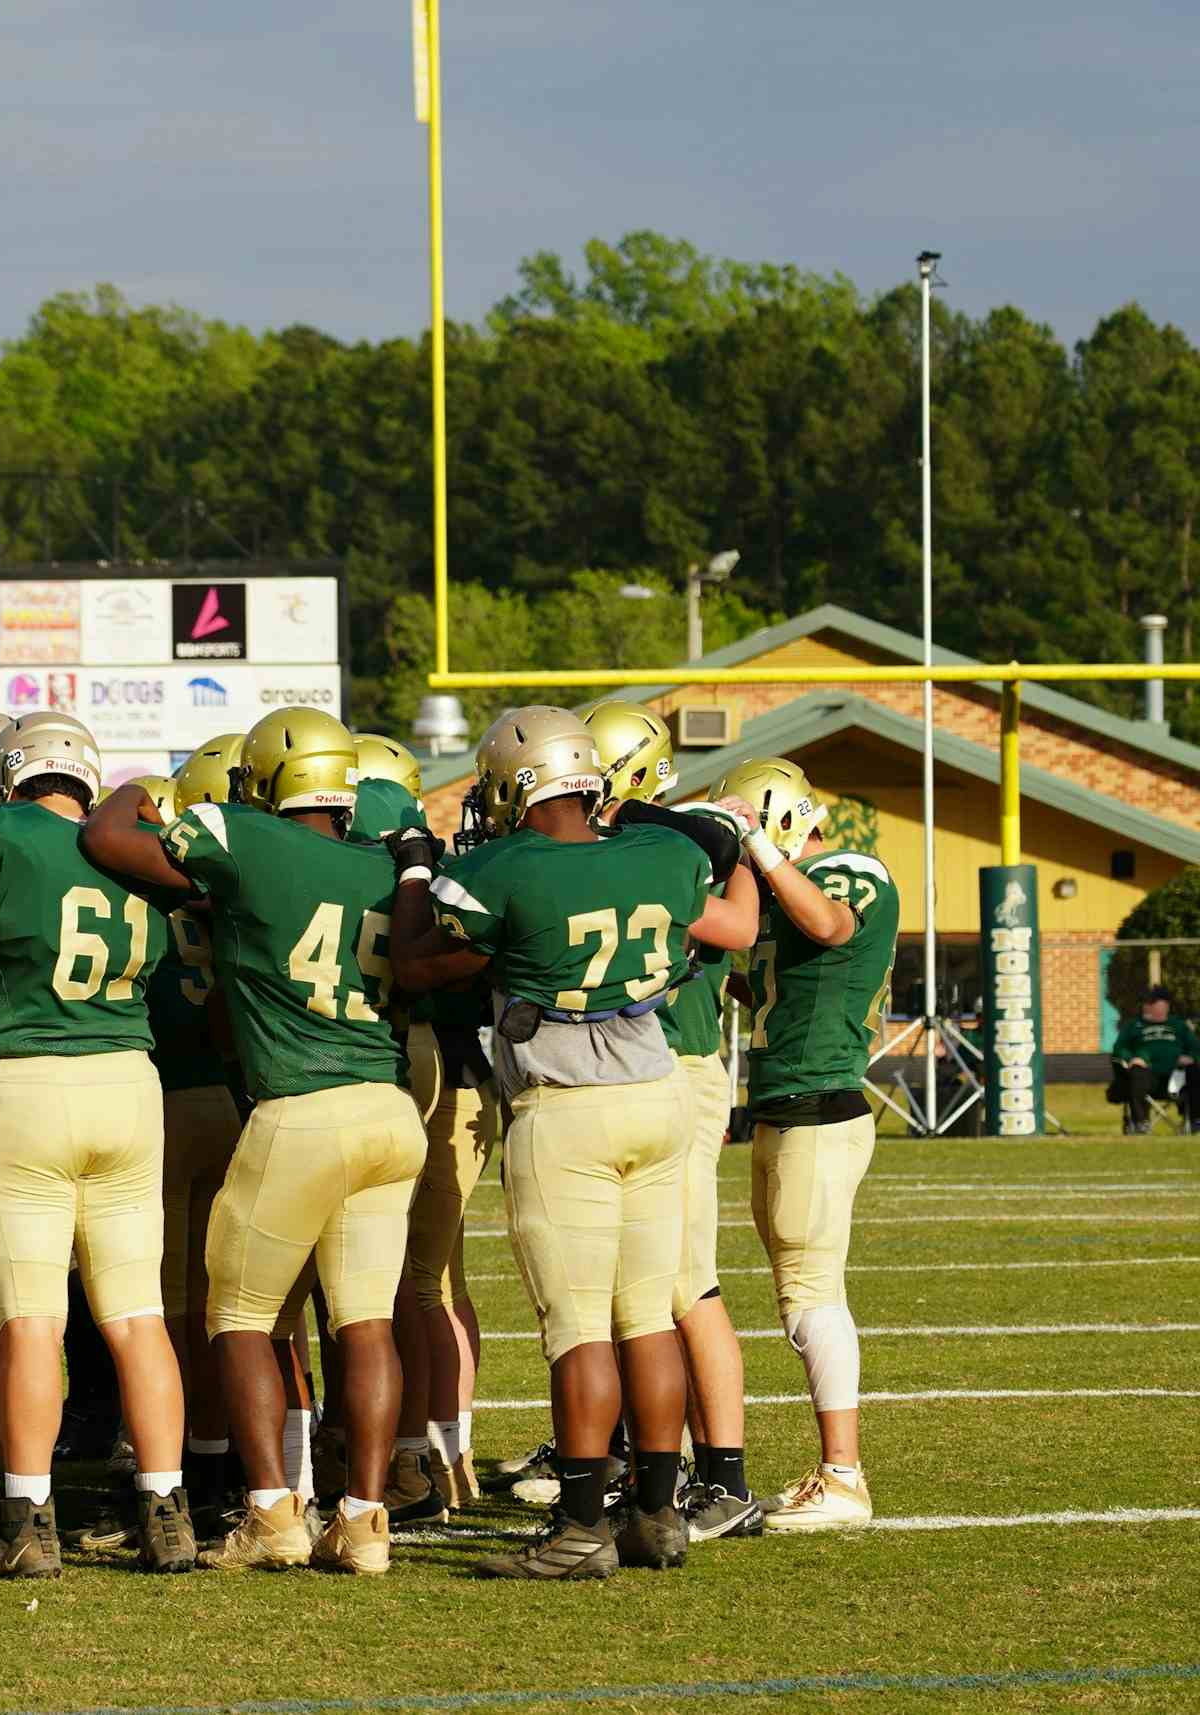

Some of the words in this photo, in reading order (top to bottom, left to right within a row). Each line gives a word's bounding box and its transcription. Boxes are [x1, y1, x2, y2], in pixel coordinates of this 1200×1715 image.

[259, 689, 334, 704] arauco
[7, 751, 23, 768] 22
[45, 760, 90, 778] Riddell
[658, 761, 669, 776] 22
[517, 769, 535, 787] 22
[797, 799, 811, 816] 22
[52, 886, 148, 1001] 61
[555, 903, 672, 1012] 73
